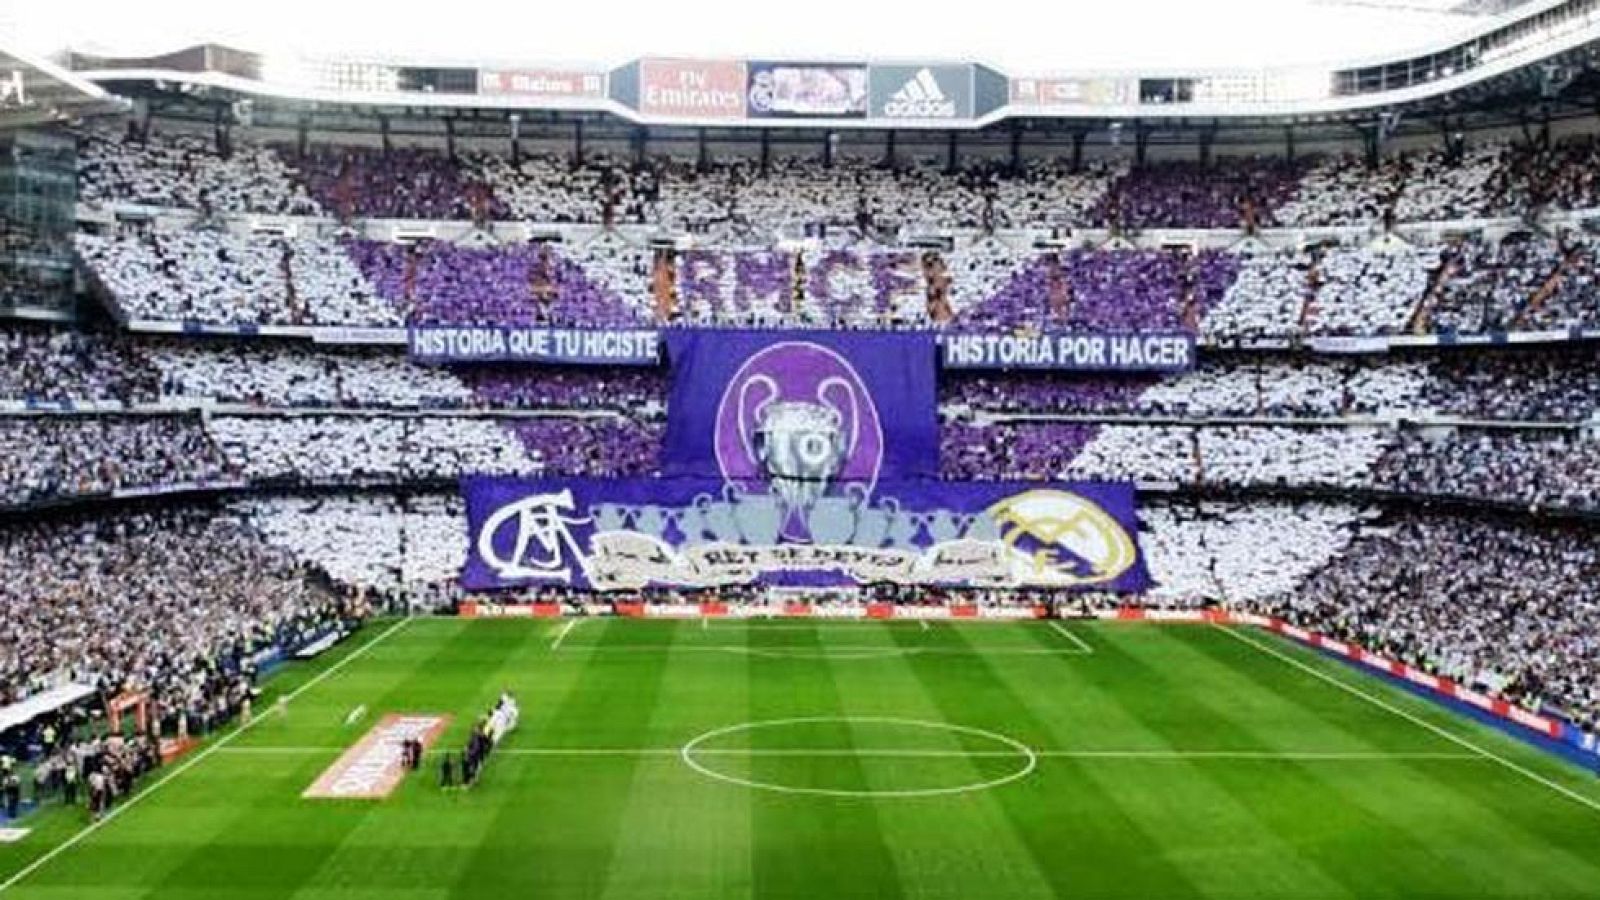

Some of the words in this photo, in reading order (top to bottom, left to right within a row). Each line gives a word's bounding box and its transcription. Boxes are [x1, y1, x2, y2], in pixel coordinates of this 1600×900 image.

[413, 328, 505, 356] HISTORIA
[508, 329, 549, 355] QUE
[553, 330, 581, 356] TU
[583, 331, 658, 357] HICISTE
[947, 335, 1053, 363] HISTORIA
[1059, 337, 1106, 364] POR
[1111, 337, 1189, 364] HACER
